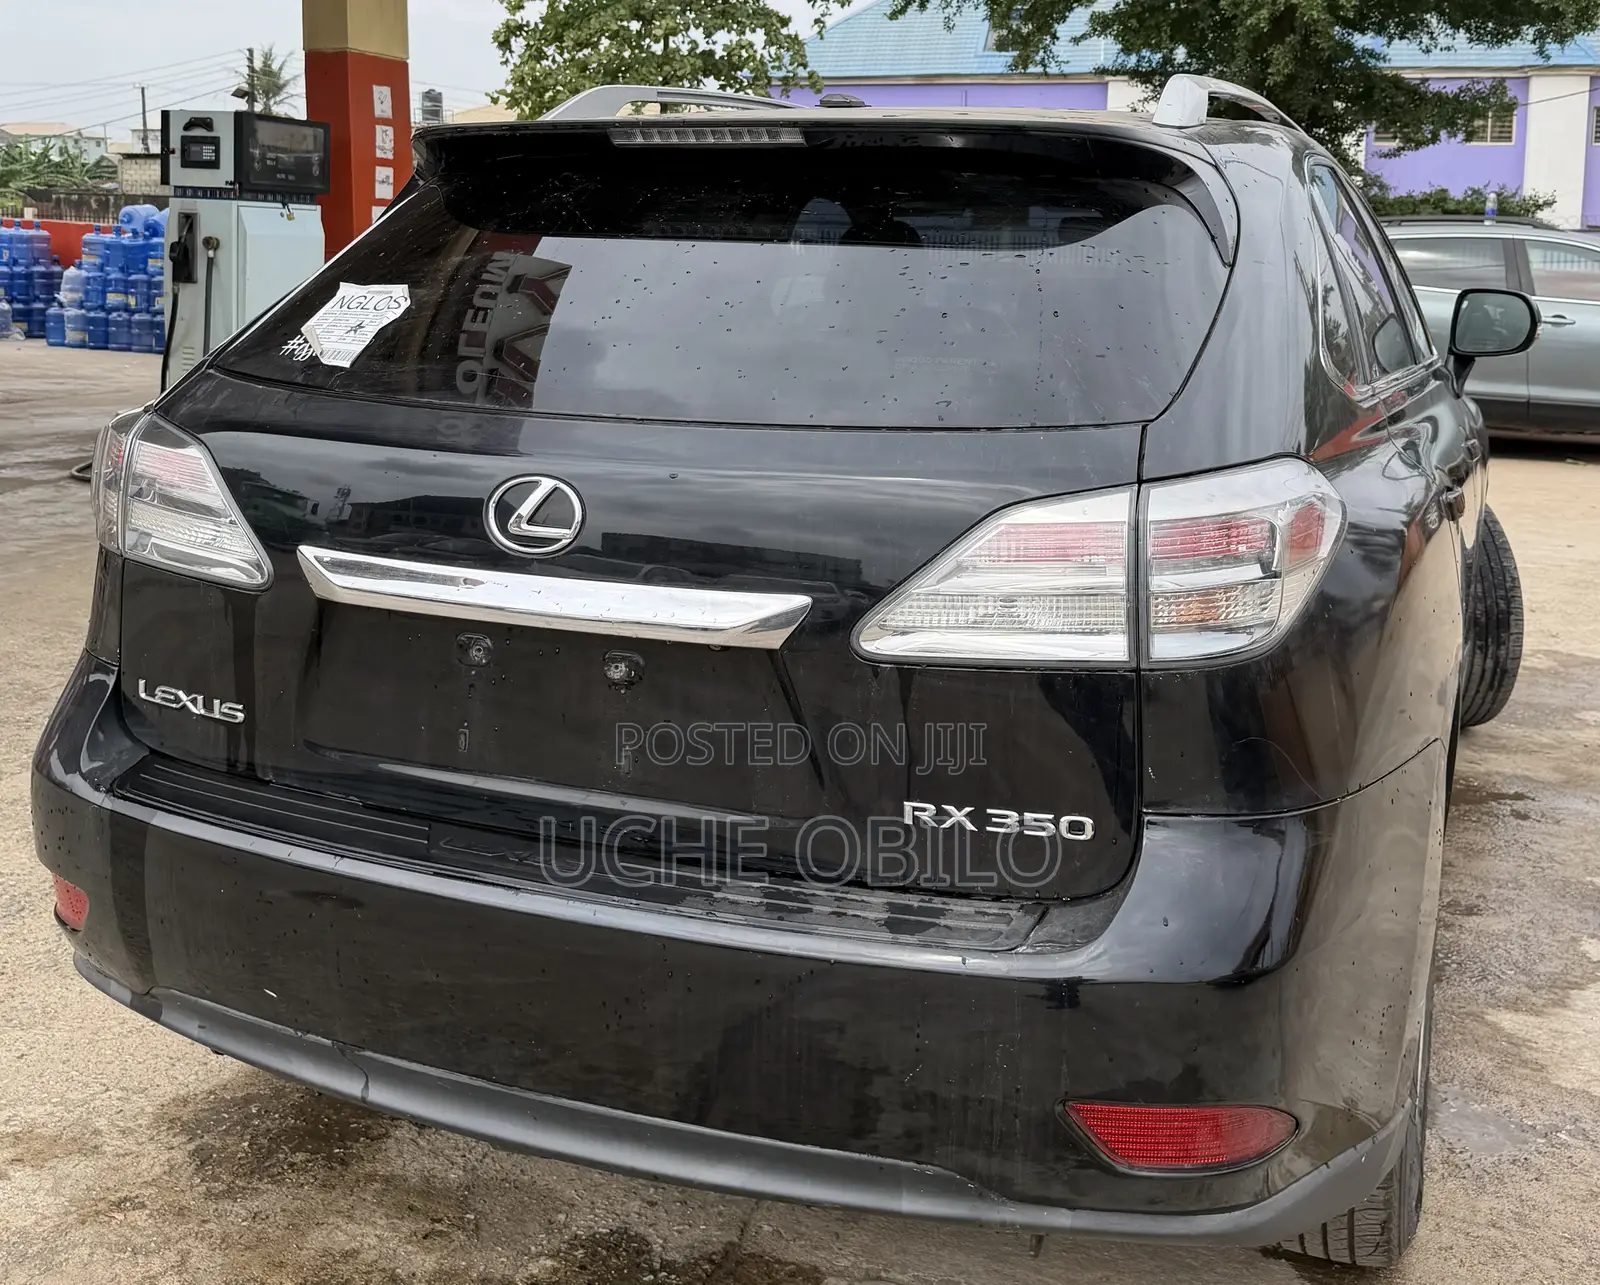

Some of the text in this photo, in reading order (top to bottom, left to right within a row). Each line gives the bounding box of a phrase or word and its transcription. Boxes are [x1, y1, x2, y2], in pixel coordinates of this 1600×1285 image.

[331, 295, 408, 312] NGLOS
[138, 678, 245, 723] LEXUS
[903, 801, 1096, 842] RX 350
